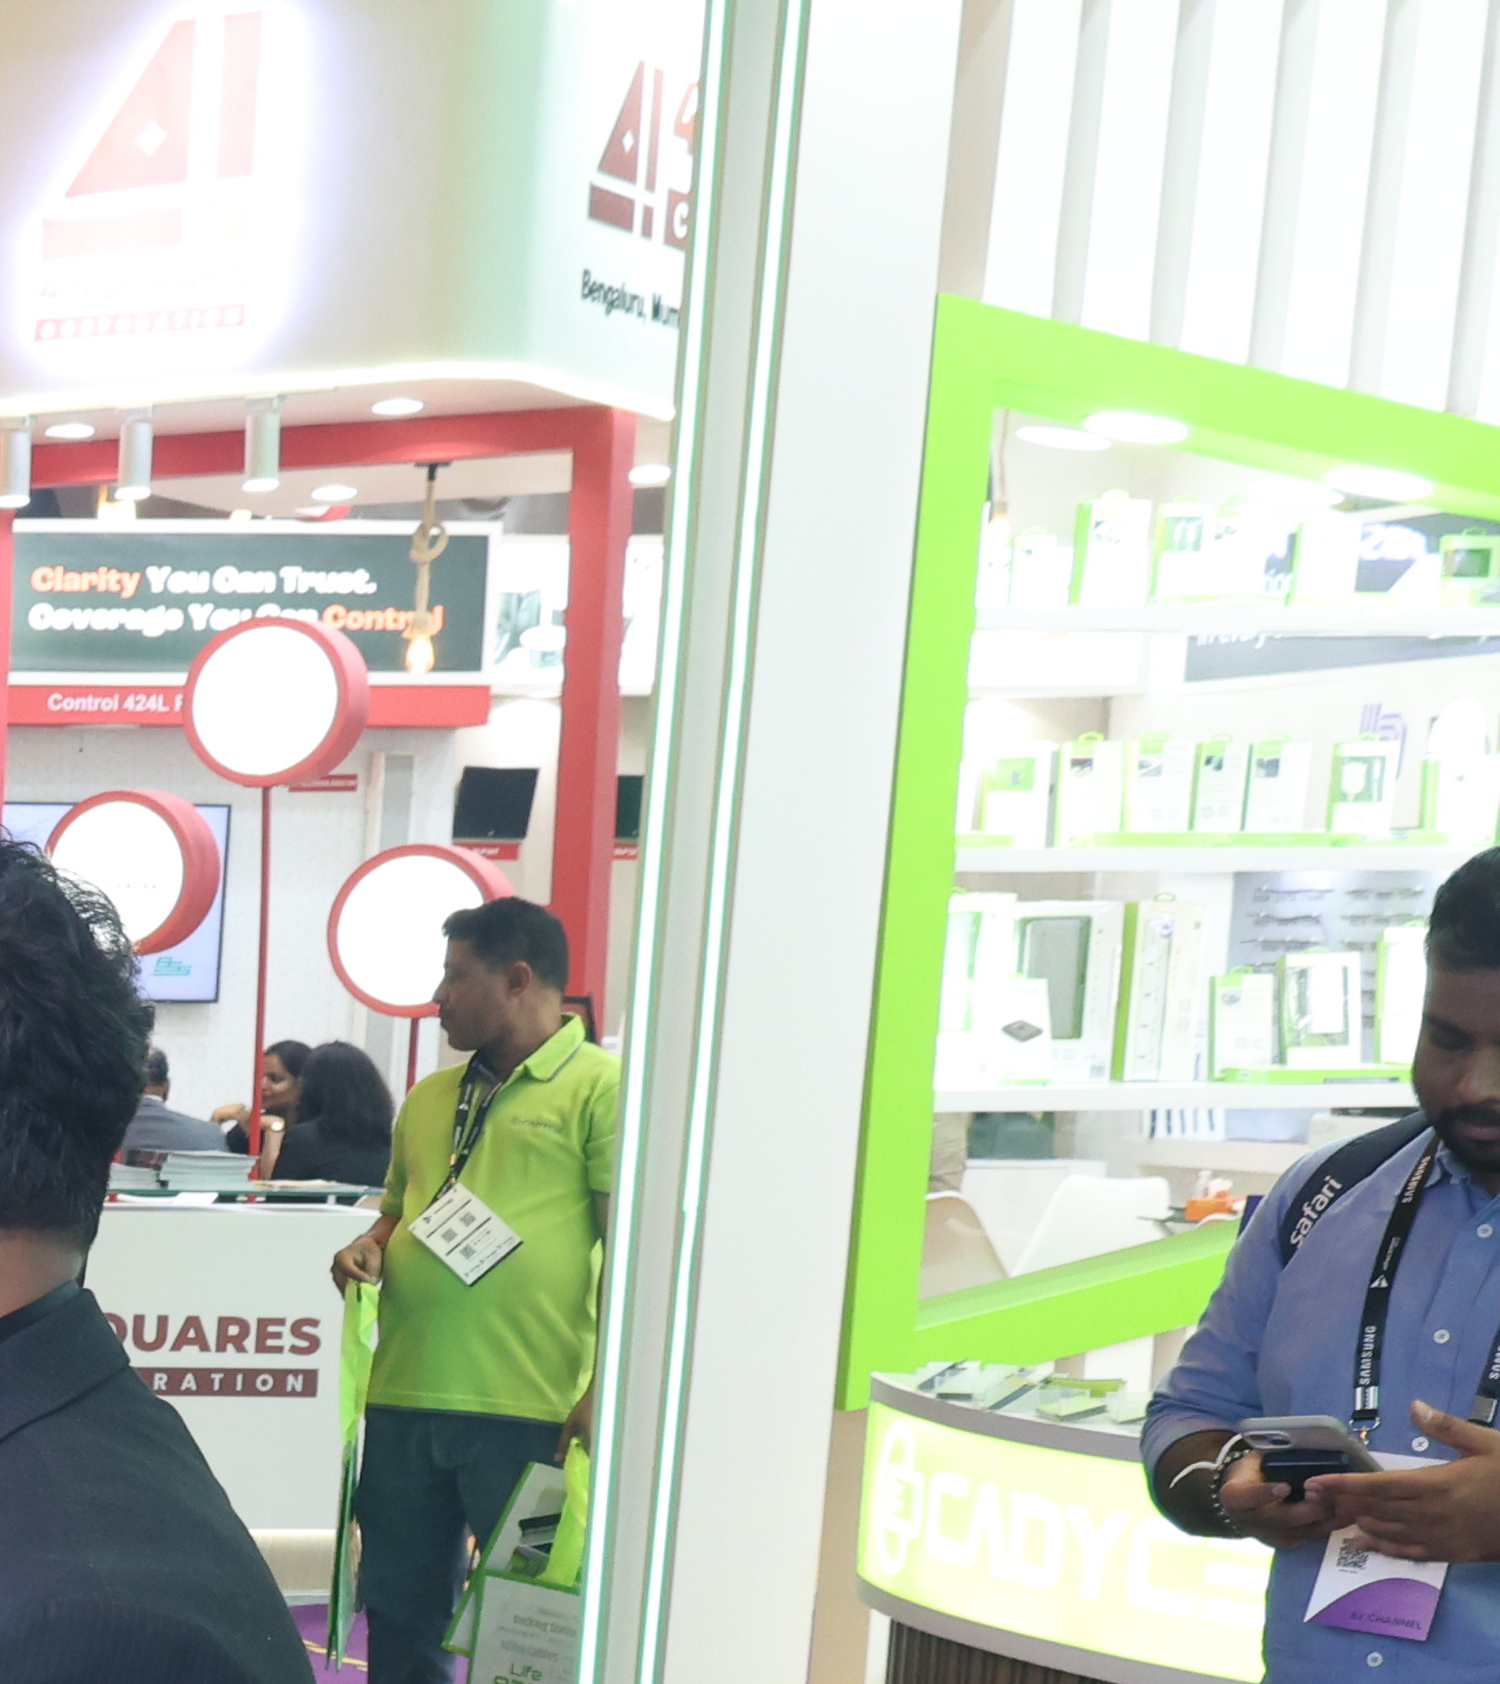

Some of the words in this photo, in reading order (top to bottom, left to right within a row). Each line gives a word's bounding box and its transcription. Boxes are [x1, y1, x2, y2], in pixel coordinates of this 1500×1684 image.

[581, 268, 647, 326] Bengaluru,
[31, 565, 142, 599] Clarity
[145, 565, 210, 595] You
[212, 565, 277, 594] Can
[280, 565, 377, 595] Trust.
[28, 603, 184, 637] Coverage
[48, 693, 119, 712] Control
[122, 693, 170, 712] 424L
[1290, 1174, 1343, 1250] safari
[1359, 1325, 1377, 1385] SAMSUNG
[153, 1372, 304, 1392] RATION
[509, 1662, 543, 1682] Life
